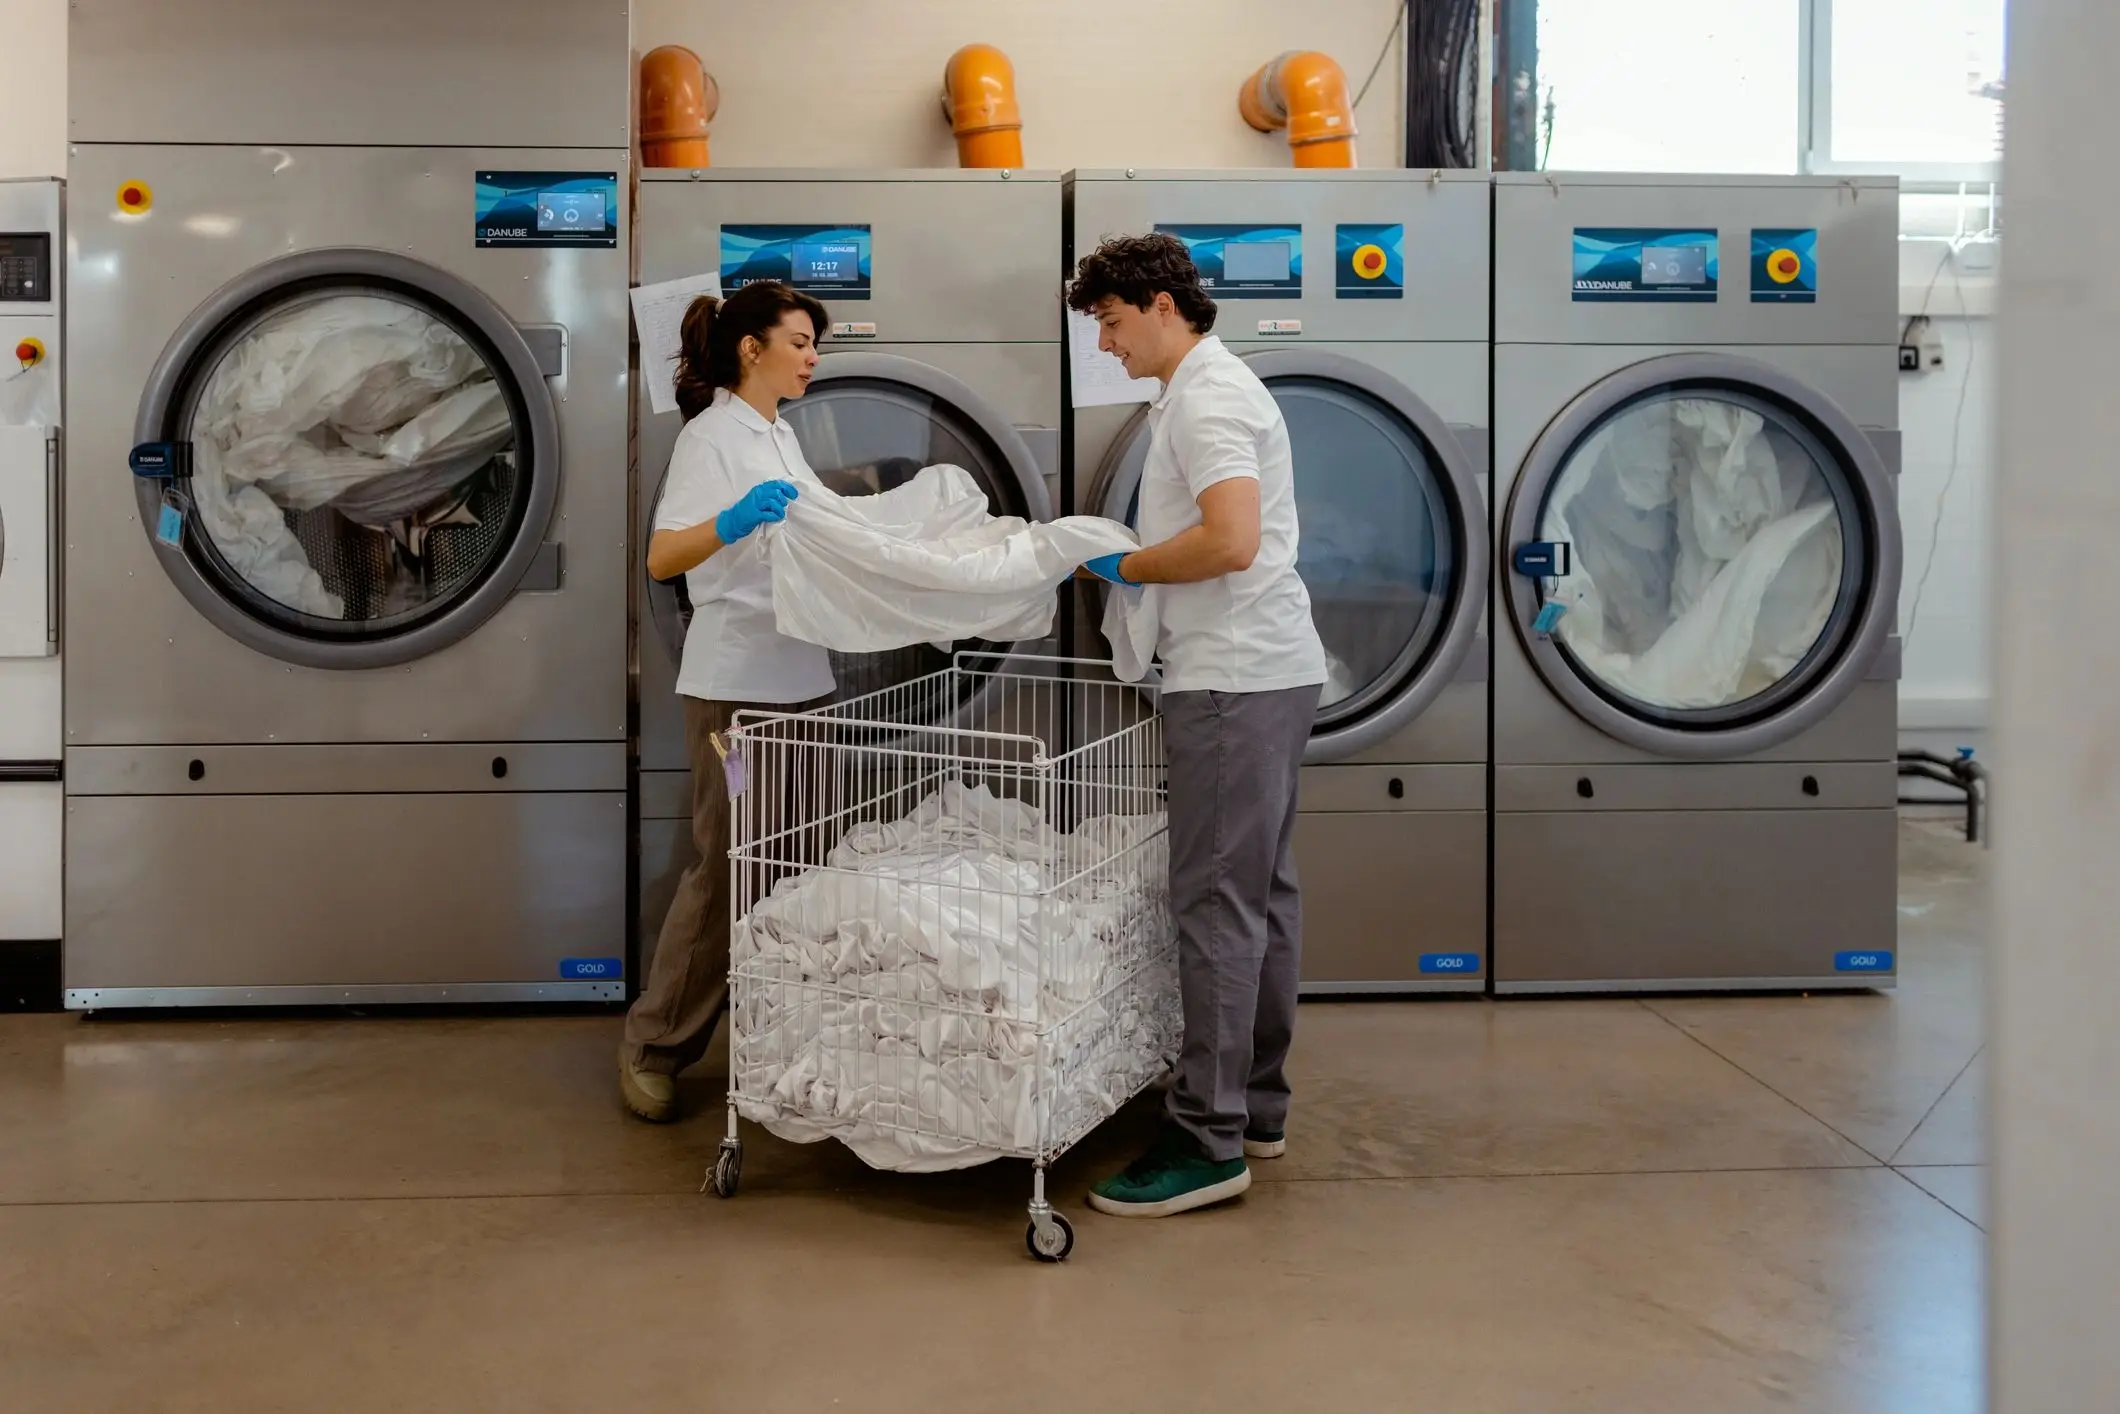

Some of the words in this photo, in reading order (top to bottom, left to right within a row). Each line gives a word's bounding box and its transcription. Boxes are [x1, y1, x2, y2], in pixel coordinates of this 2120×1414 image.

[487, 228, 528, 237] DANUBE
[811, 261, 838, 271] 12:17
[1593, 280, 1633, 290] DANUBE
[1436, 958, 1464, 968] GOLD
[1850, 955, 1877, 966] GOLD
[576, 963, 606, 974] GOLD
